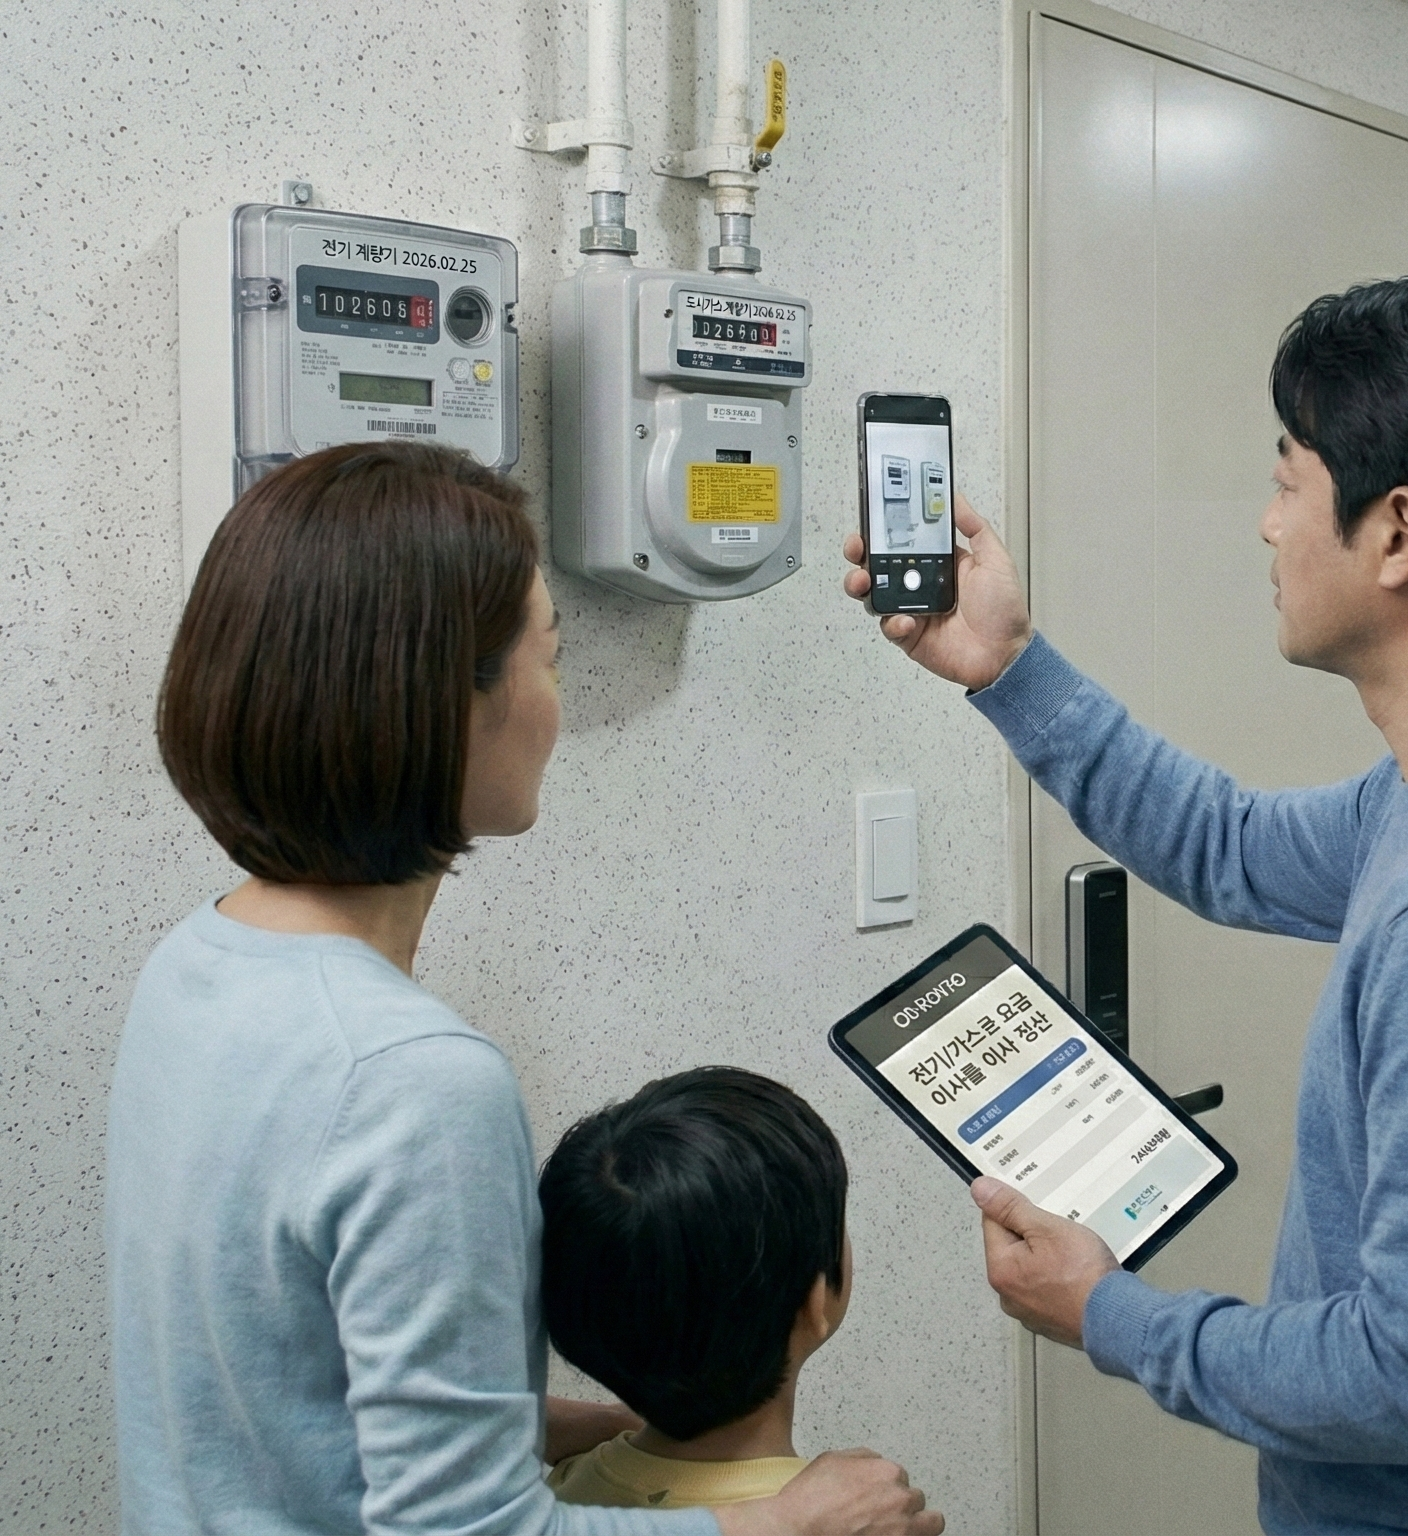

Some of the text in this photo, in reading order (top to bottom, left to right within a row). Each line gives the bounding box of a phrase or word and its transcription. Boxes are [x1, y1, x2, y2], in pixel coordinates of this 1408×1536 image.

[322, 239, 350, 259] 전기
[996, 991, 1033, 1023] 요금
[930, 1062, 987, 1106] 이사를
[981, 1035, 1021, 1066] 이사
